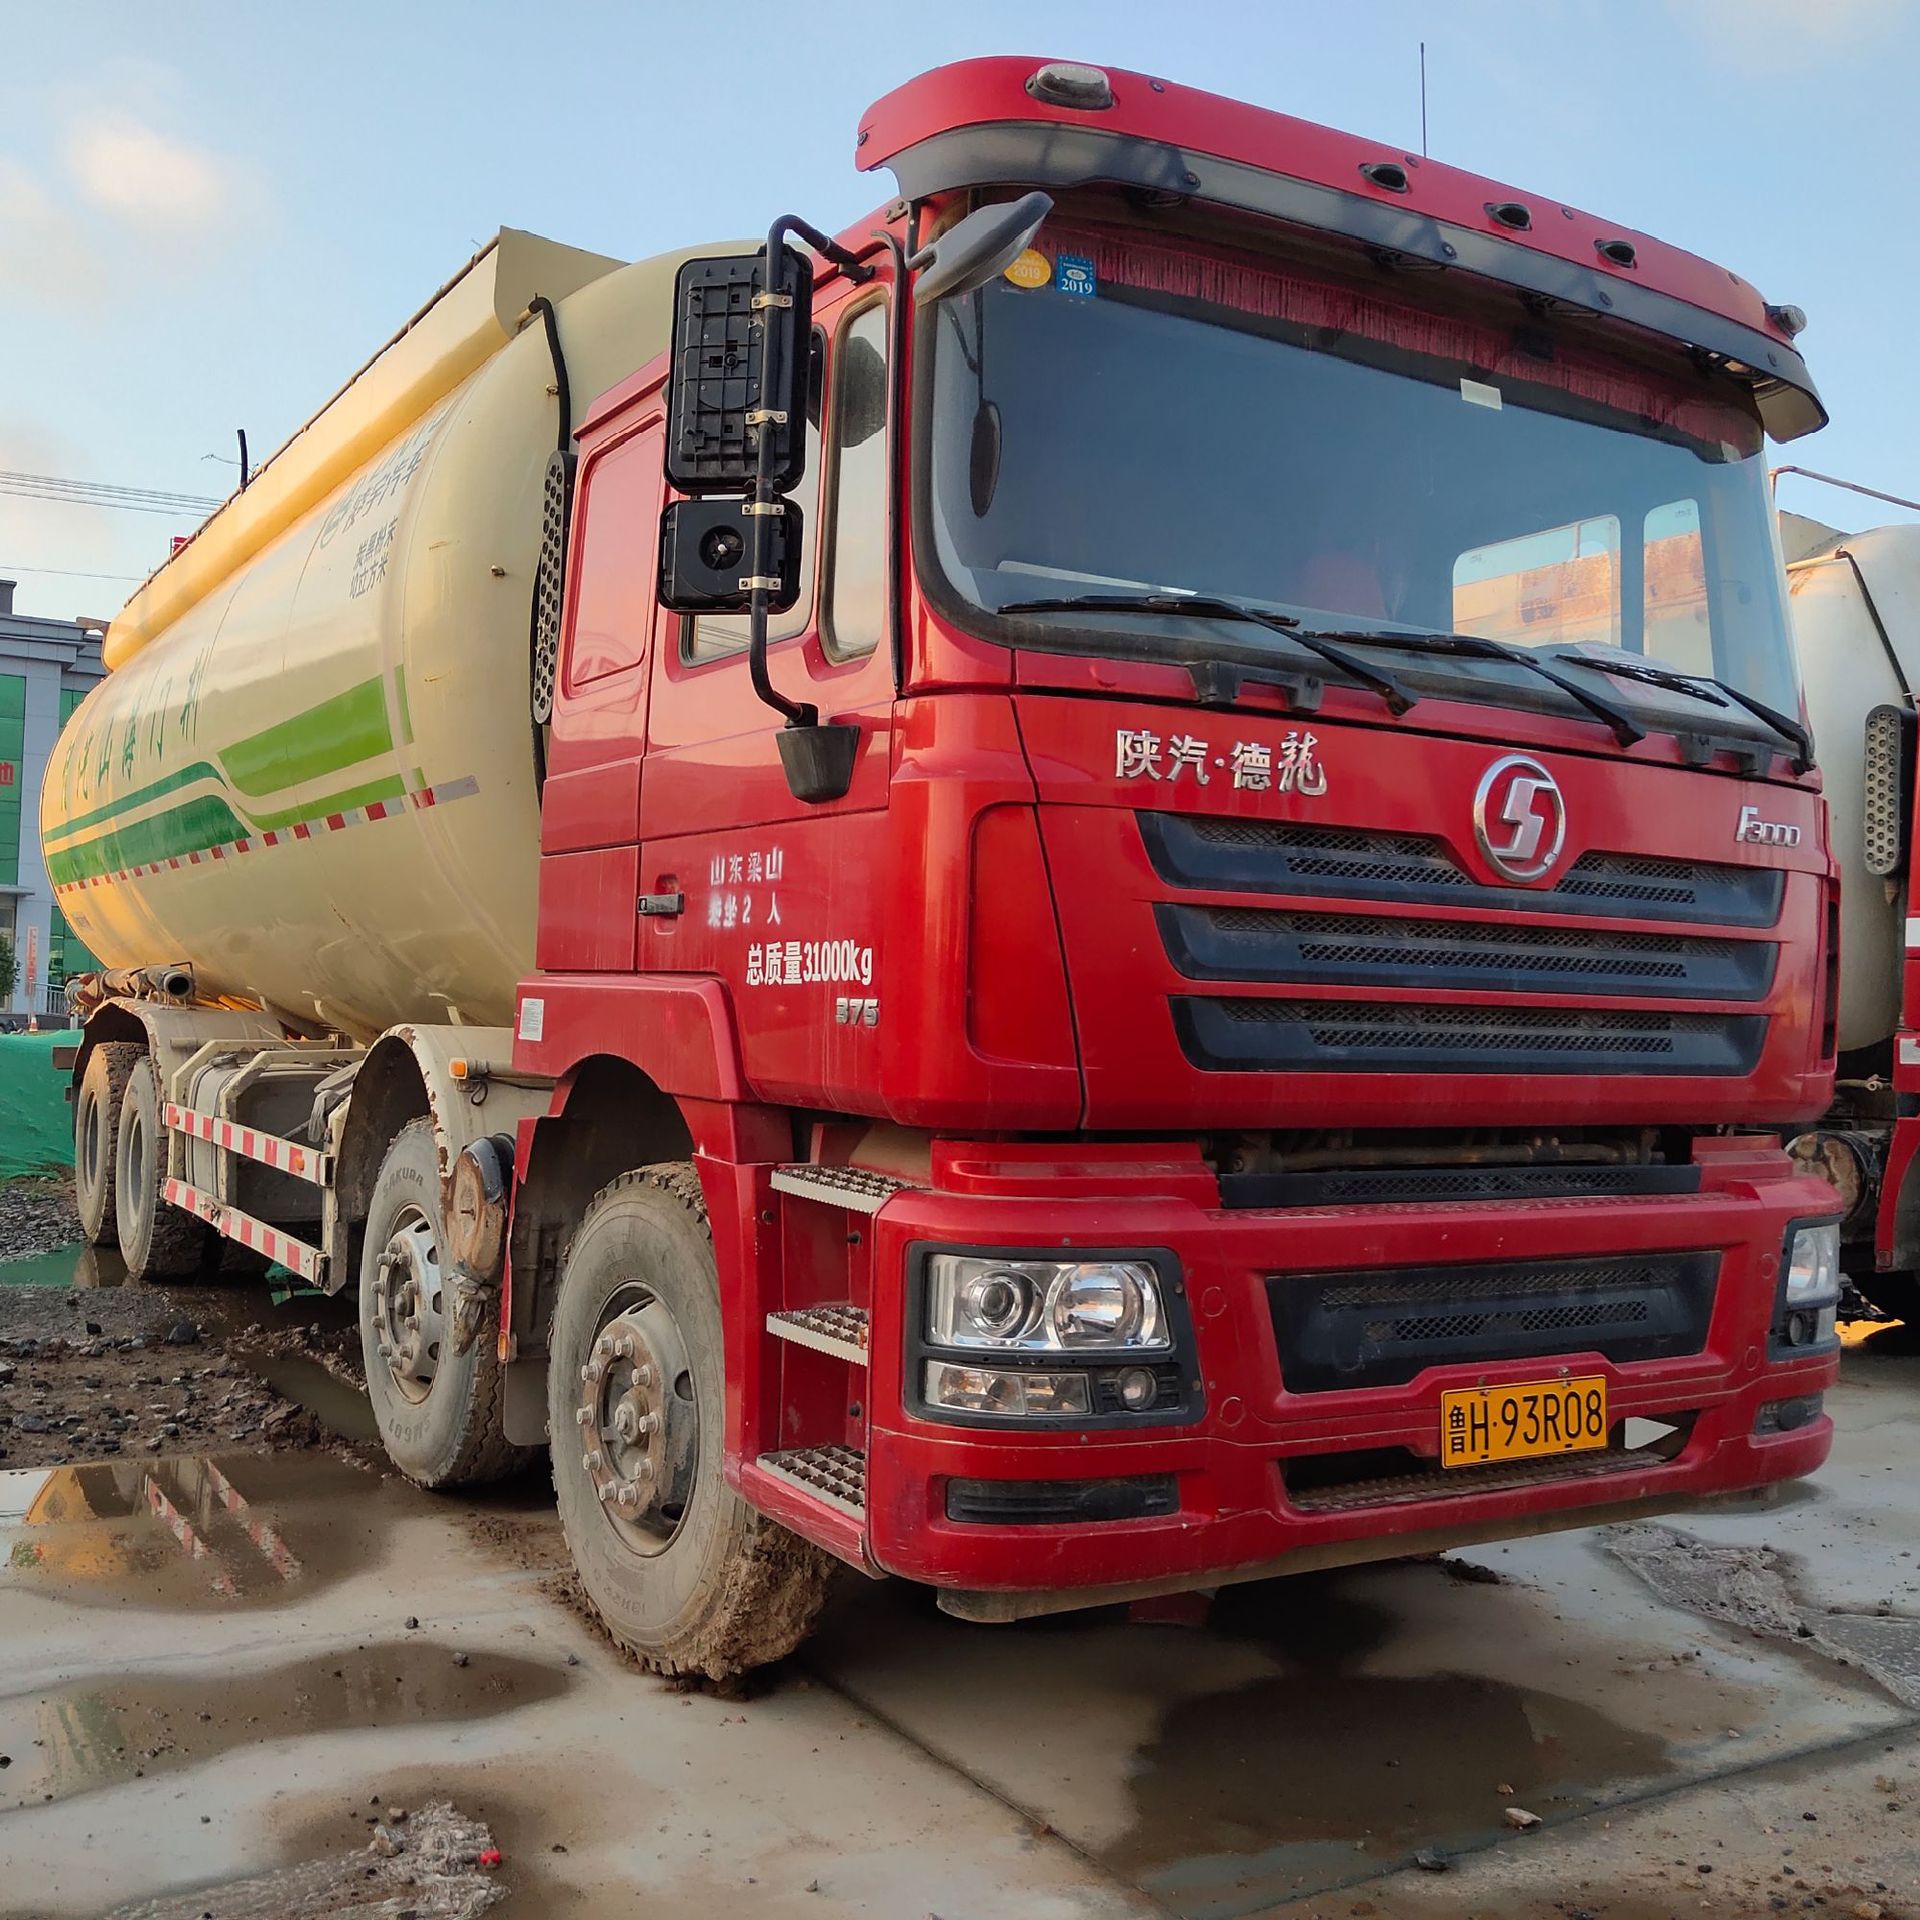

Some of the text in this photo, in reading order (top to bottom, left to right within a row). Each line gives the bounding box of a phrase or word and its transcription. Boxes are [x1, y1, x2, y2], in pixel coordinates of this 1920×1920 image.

[1014, 263, 1041, 279] 2019
[1061, 277, 1094, 295] 2019
[1735, 805, 1801, 847] F3000
[710, 846, 784, 887] 山东梁山
[746, 938, 873, 987] 总质量31000kg
[835, 997, 880, 1028] 375
